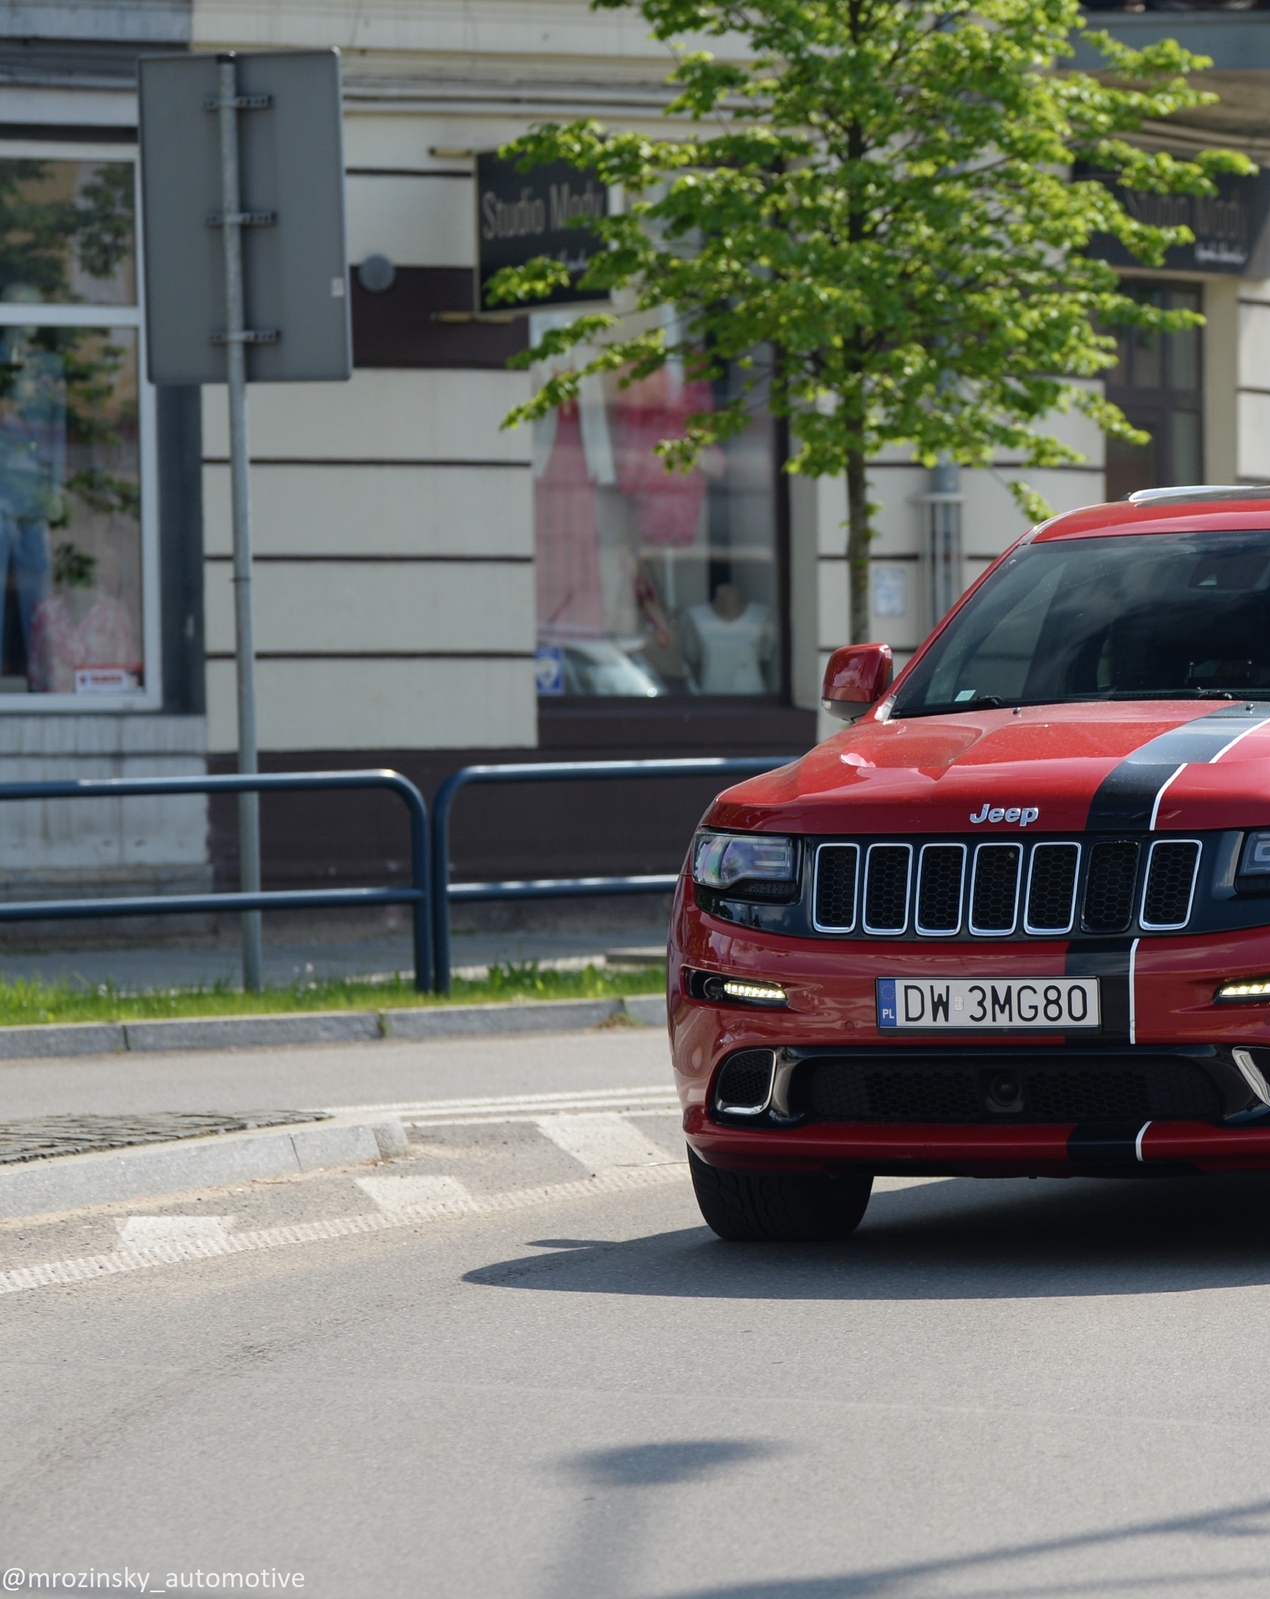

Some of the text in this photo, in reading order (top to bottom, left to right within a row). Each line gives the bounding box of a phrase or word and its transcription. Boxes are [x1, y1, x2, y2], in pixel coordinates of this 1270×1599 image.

[969, 803, 1039, 827] Jeep
[882, 1008, 895, 1019] PL
[904, 984, 1088, 1022] DW 3MG80
